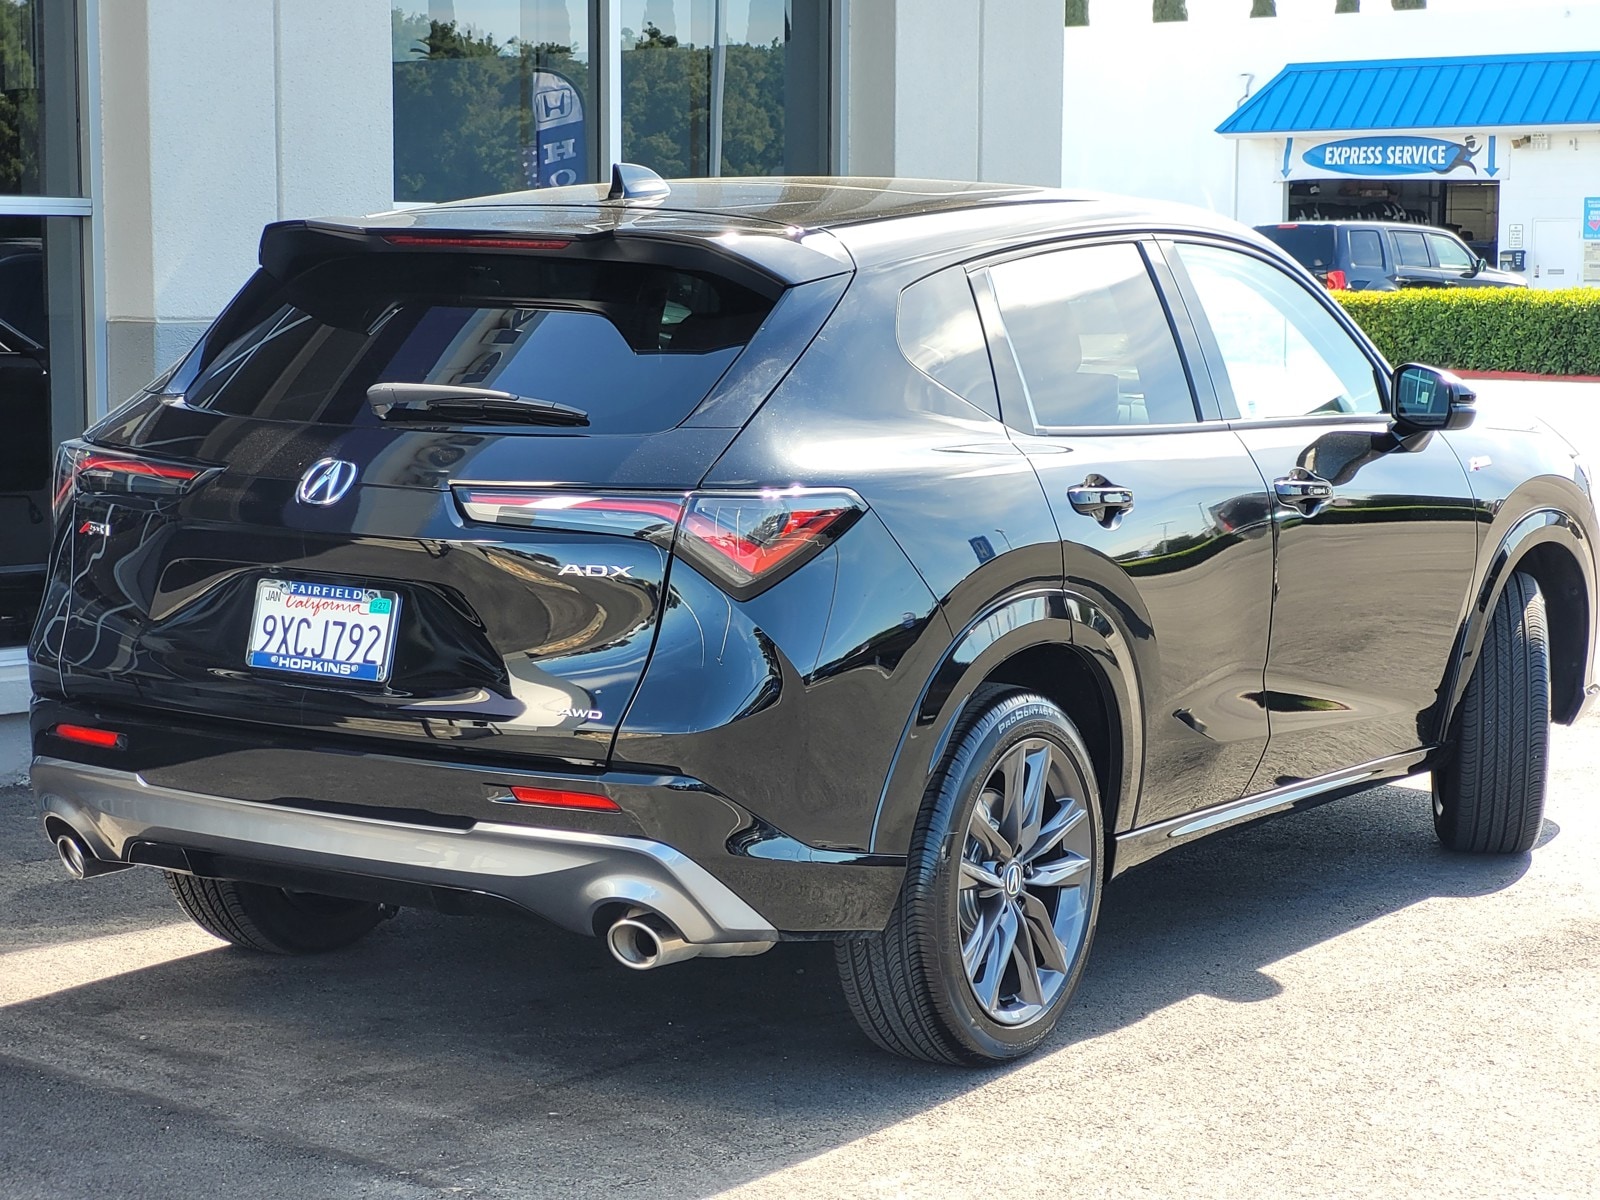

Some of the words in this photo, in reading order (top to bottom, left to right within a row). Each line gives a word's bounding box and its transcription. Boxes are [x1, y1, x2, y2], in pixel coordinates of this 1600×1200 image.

[1324, 146, 1383, 165] EXPRESS
[1386, 145, 1446, 165] SERVICE
[557, 563, 634, 578] ADX
[265, 590, 281, 602] JAN
[290, 583, 363, 600] FAIRFIELD
[286, 595, 369, 617] California
[258, 614, 382, 665] 9XCJ792
[278, 656, 351, 675] HOPKINS
[558, 708, 602, 720] AWD
